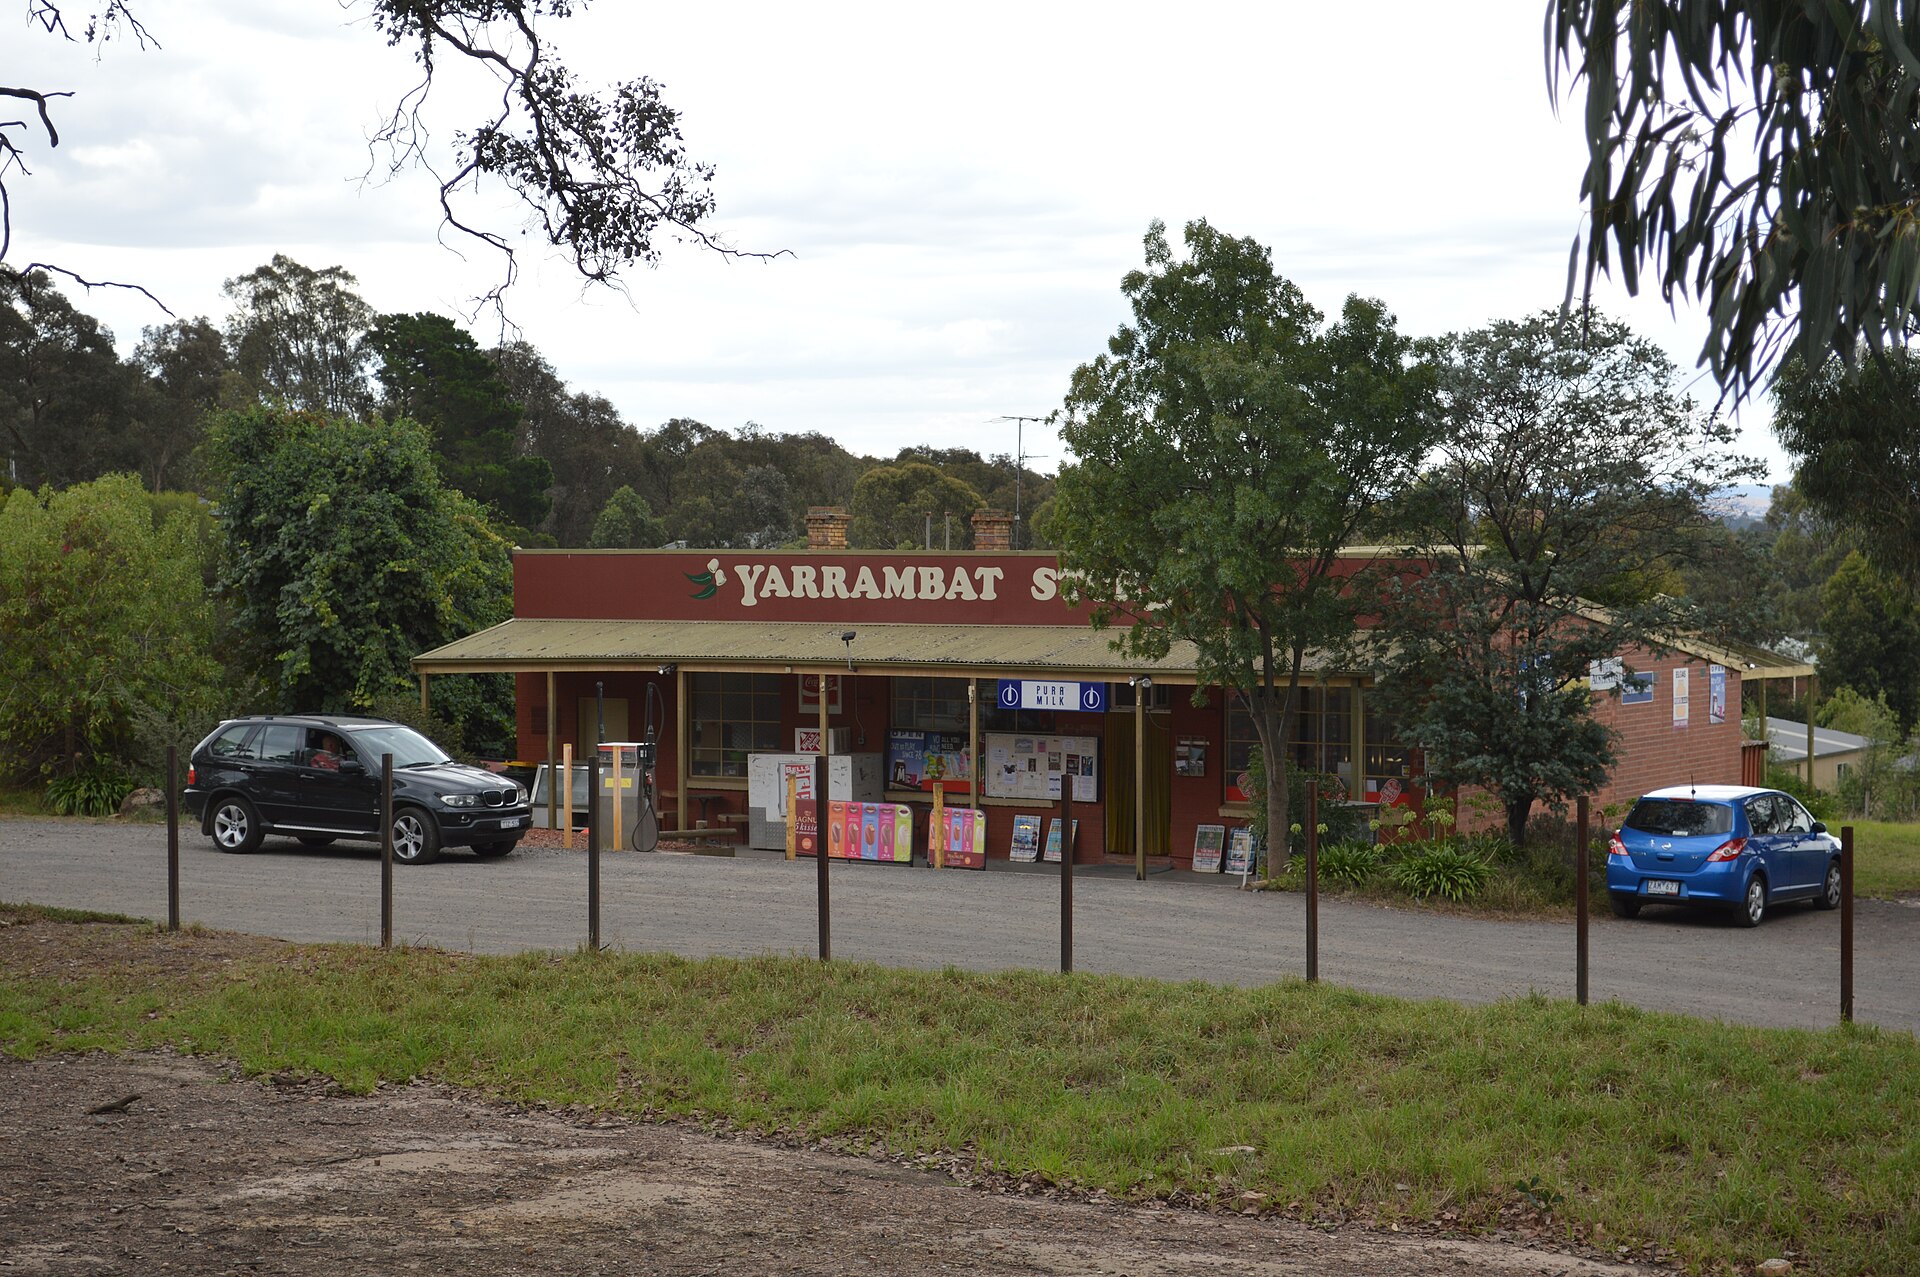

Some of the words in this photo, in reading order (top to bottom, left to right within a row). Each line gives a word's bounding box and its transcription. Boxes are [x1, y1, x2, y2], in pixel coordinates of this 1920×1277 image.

[734, 564, 1004, 606] YARRAMBAT
[1036, 685, 1064, 695] PURA
[1036, 696, 1064, 706] MILK
[891, 731, 922, 739] OPEN
[785, 765, 810, 774] BELLS
